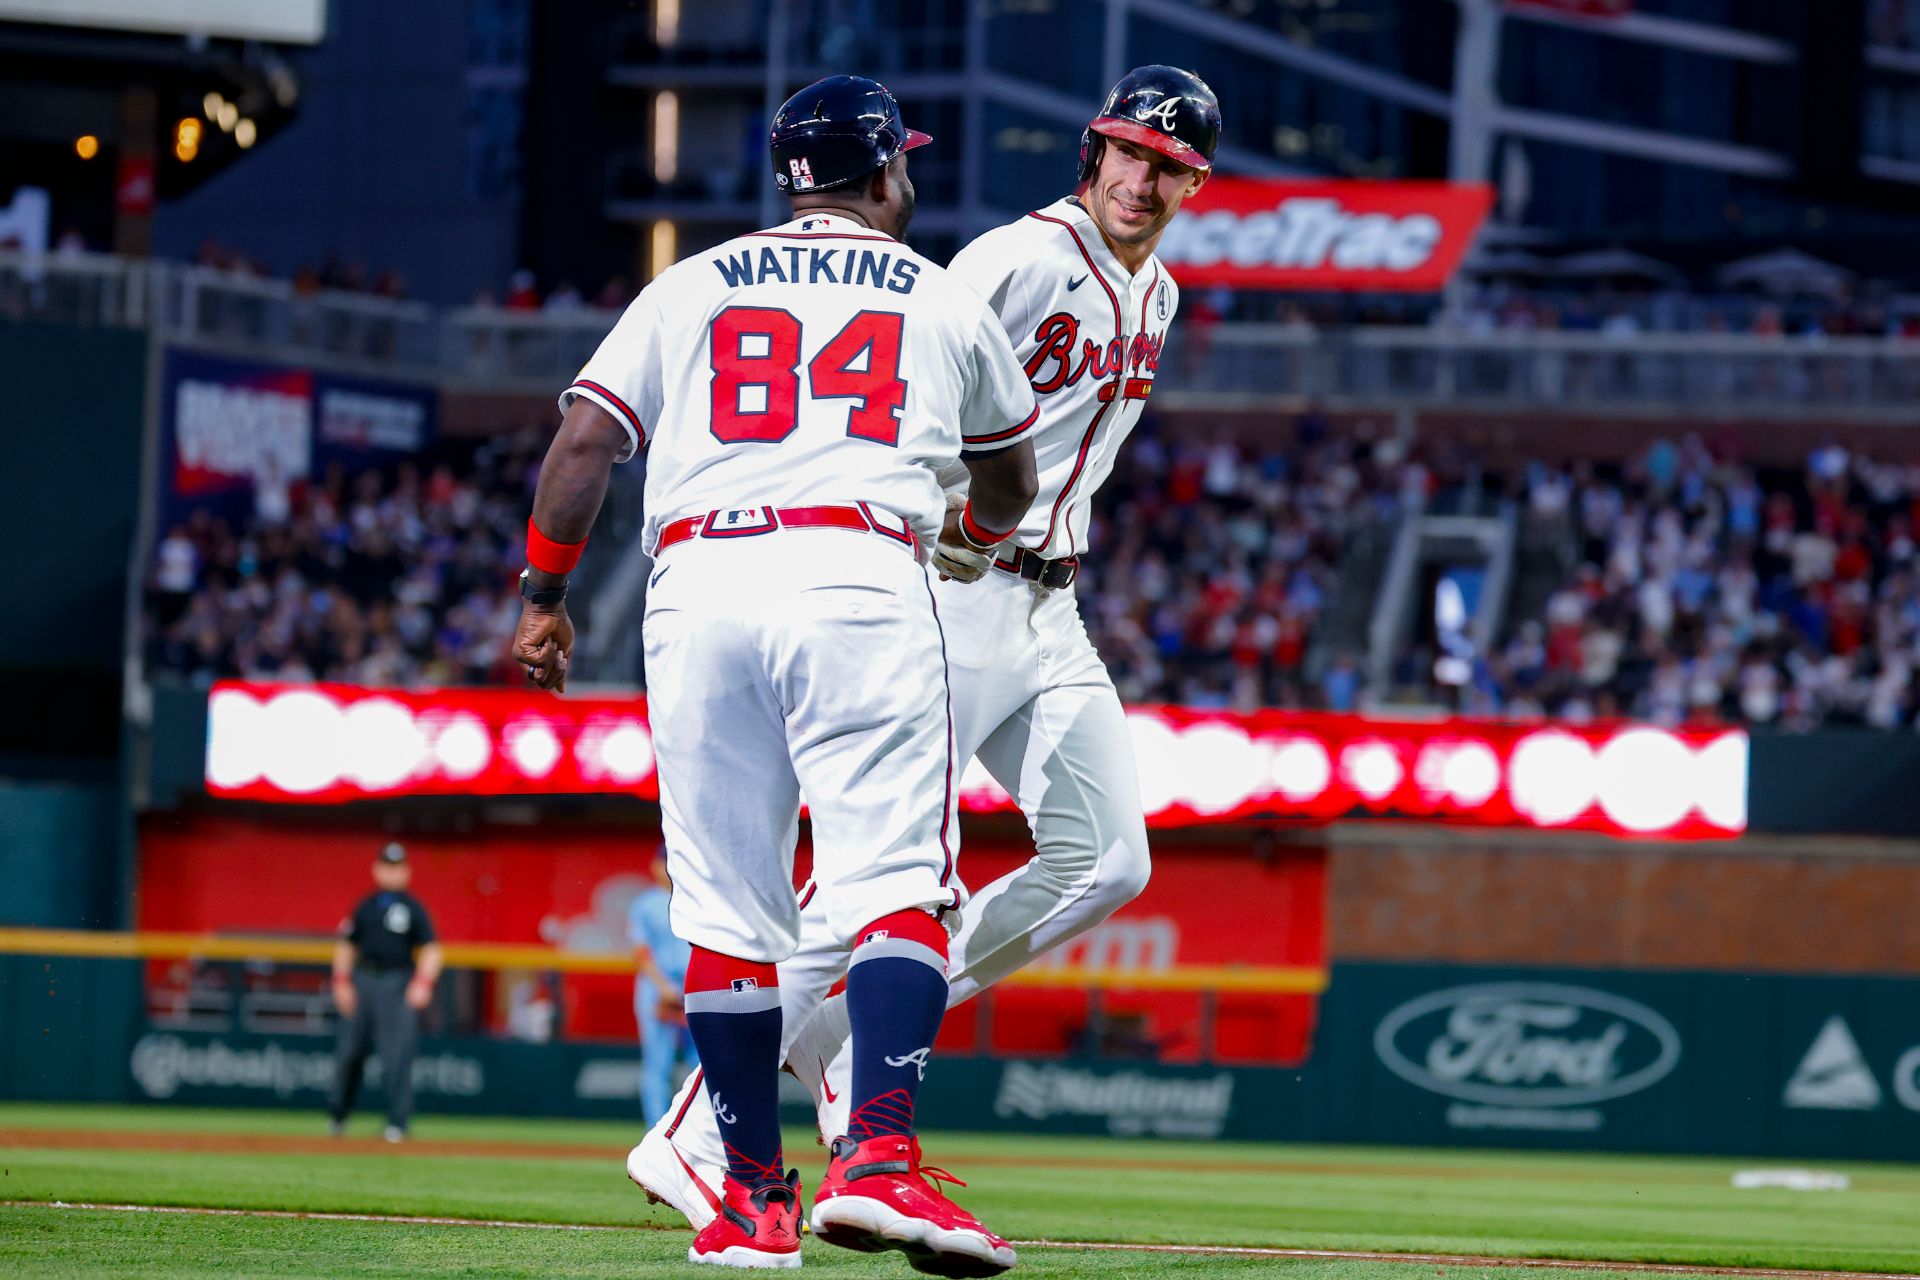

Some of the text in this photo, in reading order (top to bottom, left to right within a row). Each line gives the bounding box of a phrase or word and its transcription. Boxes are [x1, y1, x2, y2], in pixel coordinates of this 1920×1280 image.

[1136, 96, 1182, 132] A
[789, 157, 811, 176] 84
[1150, 196, 1443, 271] ceTrac
[712, 246, 921, 295] WATKINS
[1157, 284, 1166, 317] 4
[709, 305, 908, 448] 84
[133, 1035, 482, 1095] globalpants
[1427, 1002, 1628, 1087] Ford
[1048, 1064, 1233, 1117] National
